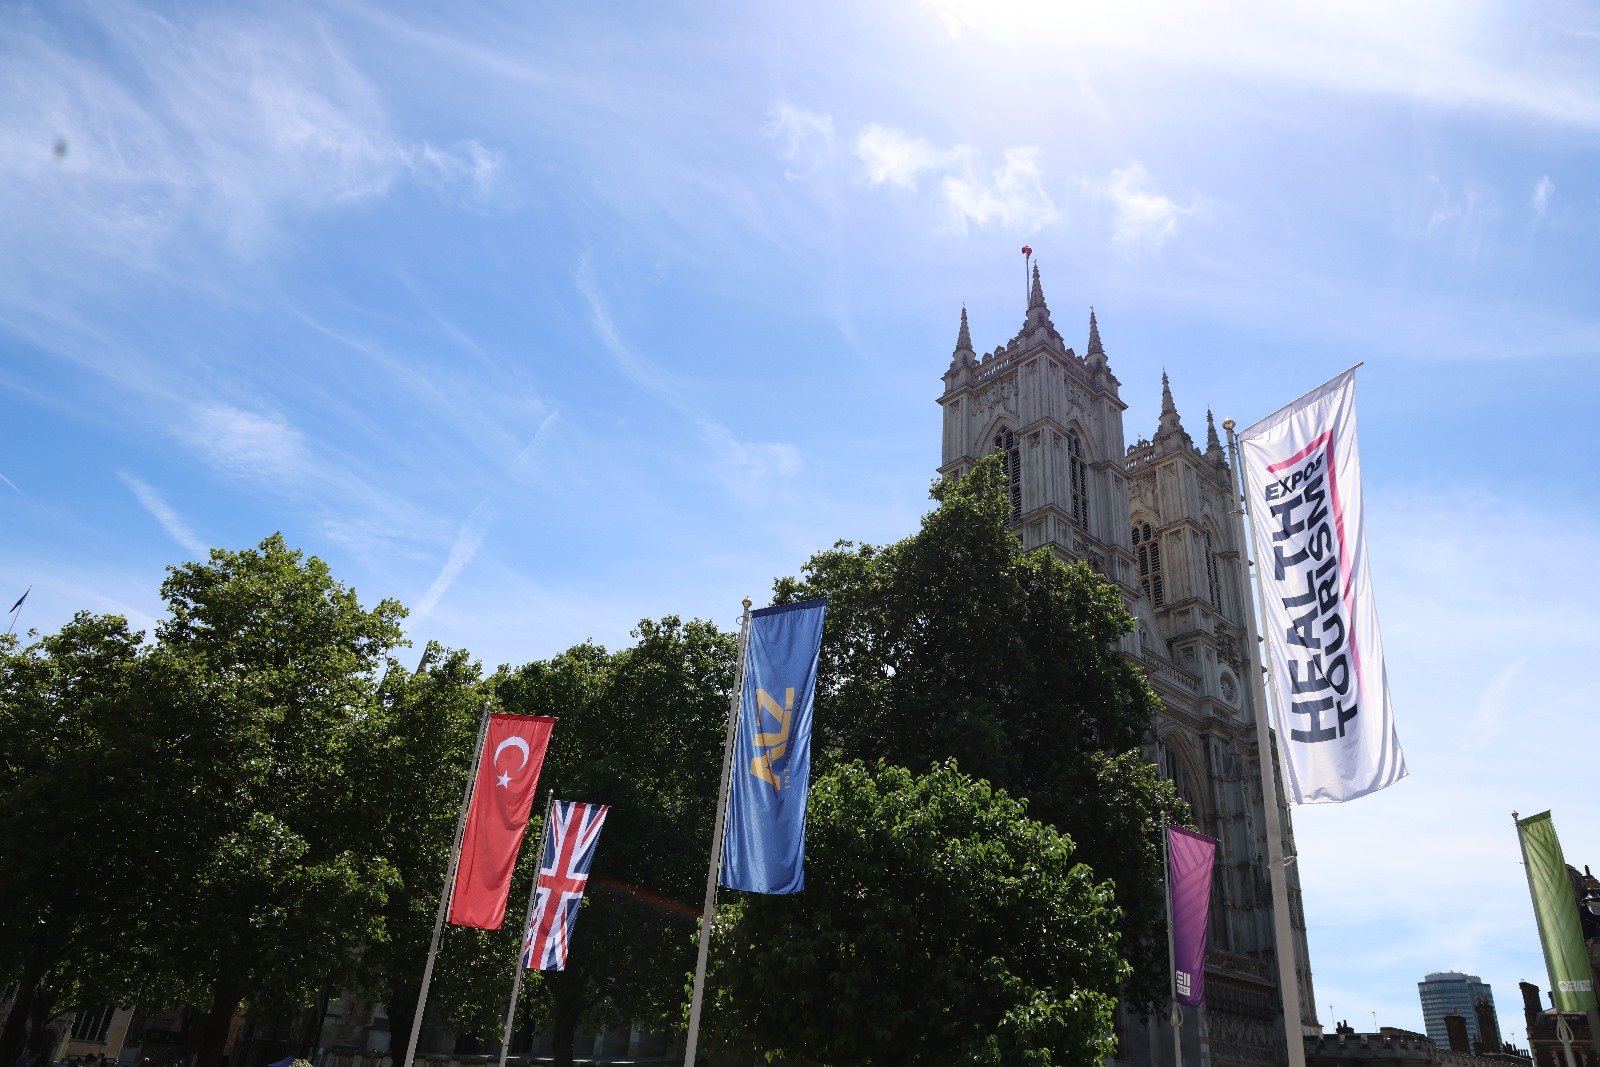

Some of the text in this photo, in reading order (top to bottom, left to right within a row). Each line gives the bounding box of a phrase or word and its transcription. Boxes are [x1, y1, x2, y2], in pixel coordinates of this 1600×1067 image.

[1265, 452, 1324, 501] EXPOS
[1271, 493, 1337, 744] HEALTH
[1303, 472, 1358, 739] TOURISM
